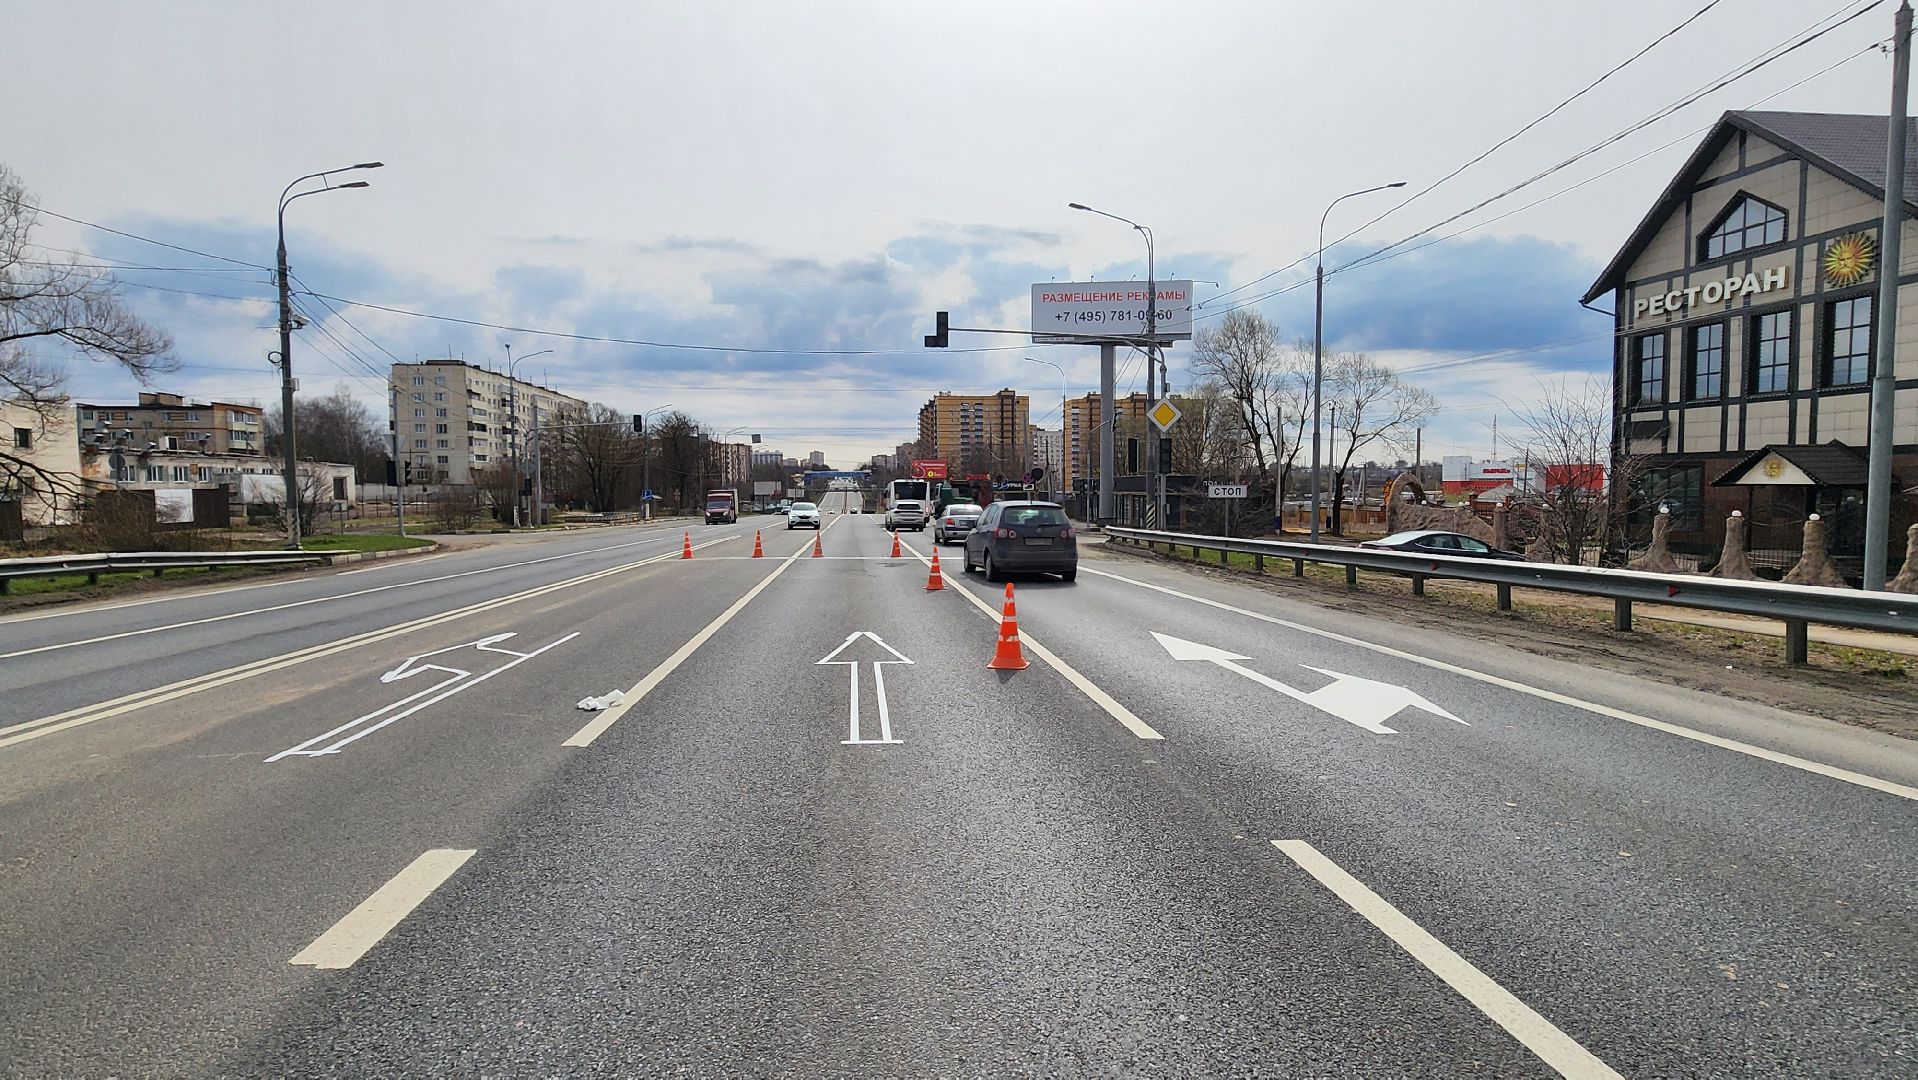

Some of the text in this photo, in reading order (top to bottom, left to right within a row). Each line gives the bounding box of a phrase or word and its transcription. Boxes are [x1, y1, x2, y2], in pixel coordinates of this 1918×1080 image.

[1042, 290, 1186, 304] РАЗМЕЩЕНИЕ РЕКАМЫ
[1633, 265, 1790, 319] РЕСТОРАН
[1054, 311, 1071, 323] +7
[1074, 310, 1106, 325] (495)
[1213, 487, 1242, 496] СТОП
